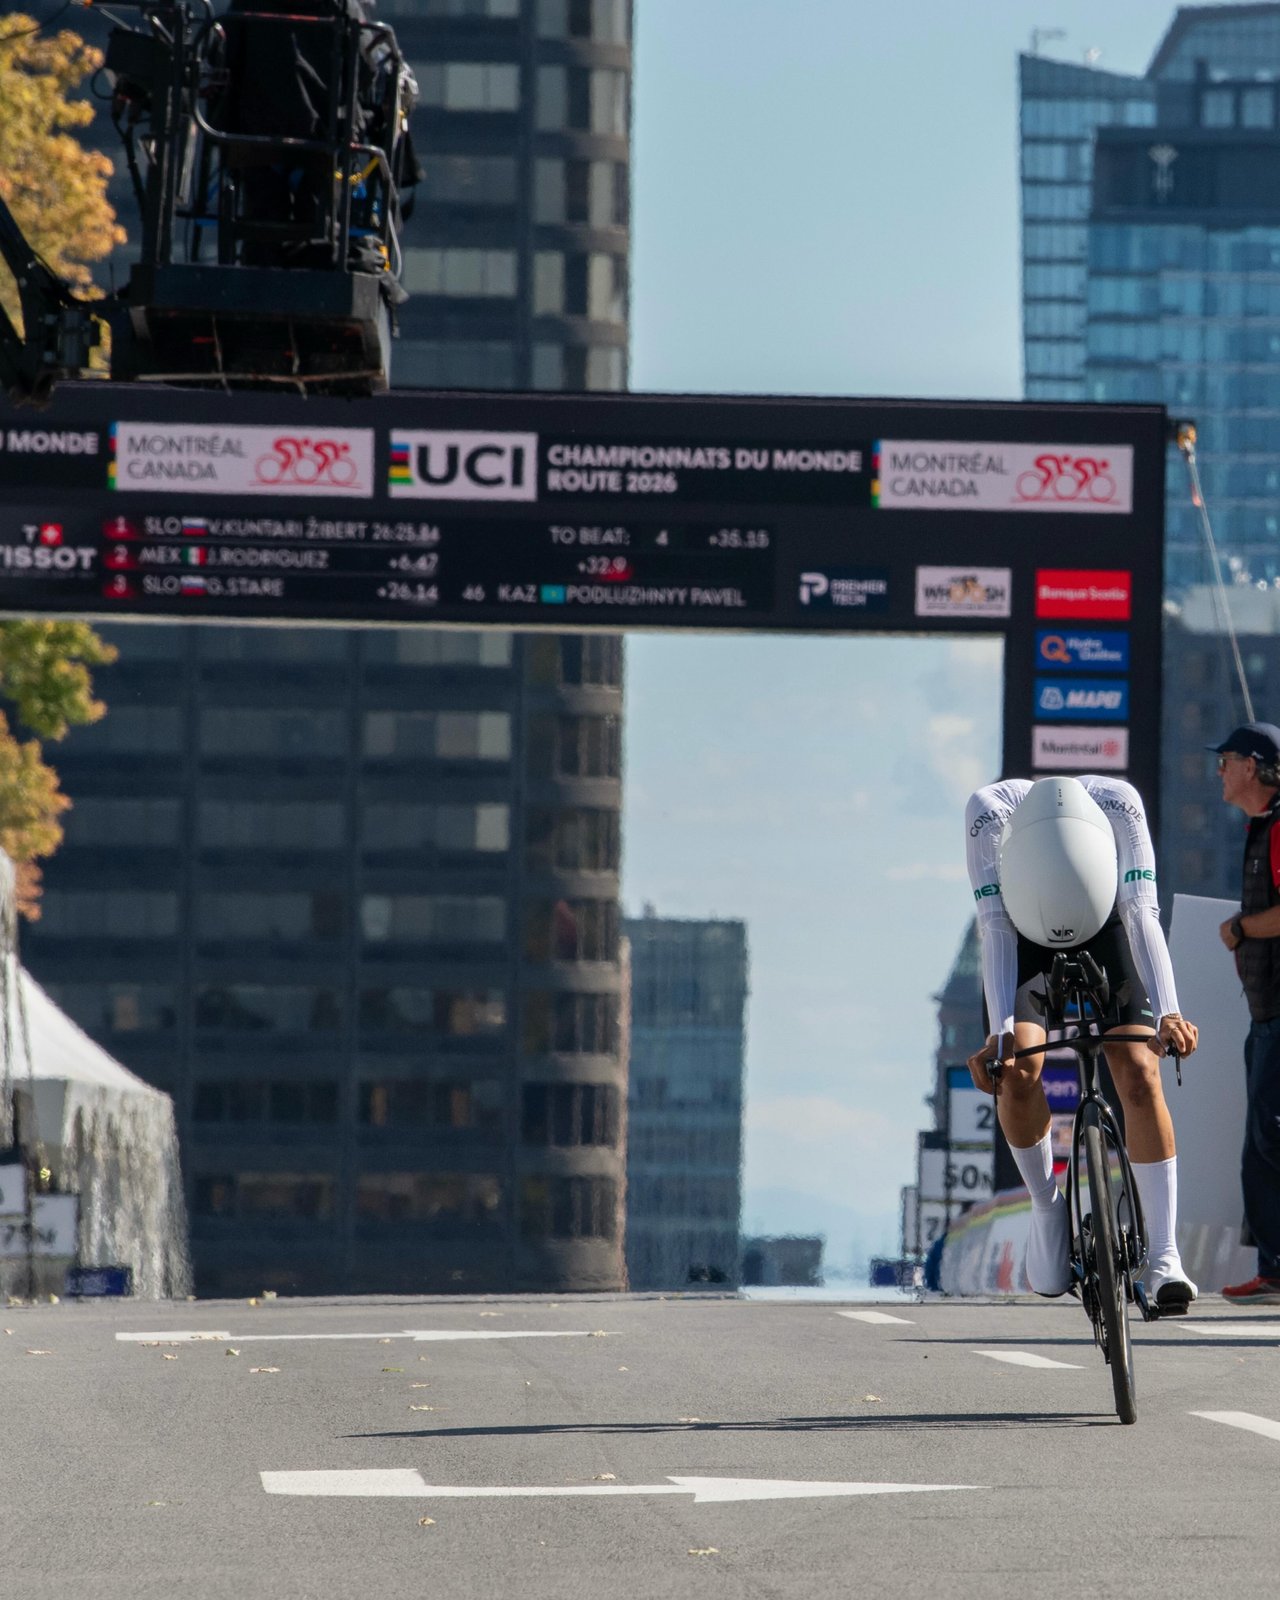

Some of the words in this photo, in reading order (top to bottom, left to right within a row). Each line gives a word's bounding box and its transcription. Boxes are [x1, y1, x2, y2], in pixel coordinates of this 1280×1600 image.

[8, 430, 98, 454] MONDE
[127, 432, 247, 459] MONTRÉAL
[416, 444, 524, 487] UCI
[548, 444, 730, 470] CHAMPIONNATS
[735, 448, 768, 471] DU
[773, 450, 862, 472] MONDE
[889, 452, 1007, 475] MONTRÉAL
[127, 460, 217, 481] CANADA
[548, 468, 621, 492] ROUTE
[627, 471, 677, 493] 2026
[889, 477, 978, 497] CANADA
[144, 516, 181, 535] SLO
[548, 526, 576, 544] TO
[578, 528, 631, 546] BEAT:
[656, 530, 669, 547] 4
[0, 545, 97, 570] ISSOT
[114, 545, 128, 564] 2
[138, 547, 180, 565] MEX
[142, 575, 179, 595] SLO
[497, 584, 537, 603] KAZ
[690, 588, 747, 607] PAVEL
[1066, 691, 1122, 709] MAPEI
[1096, 800, 1143, 823] ONADE
